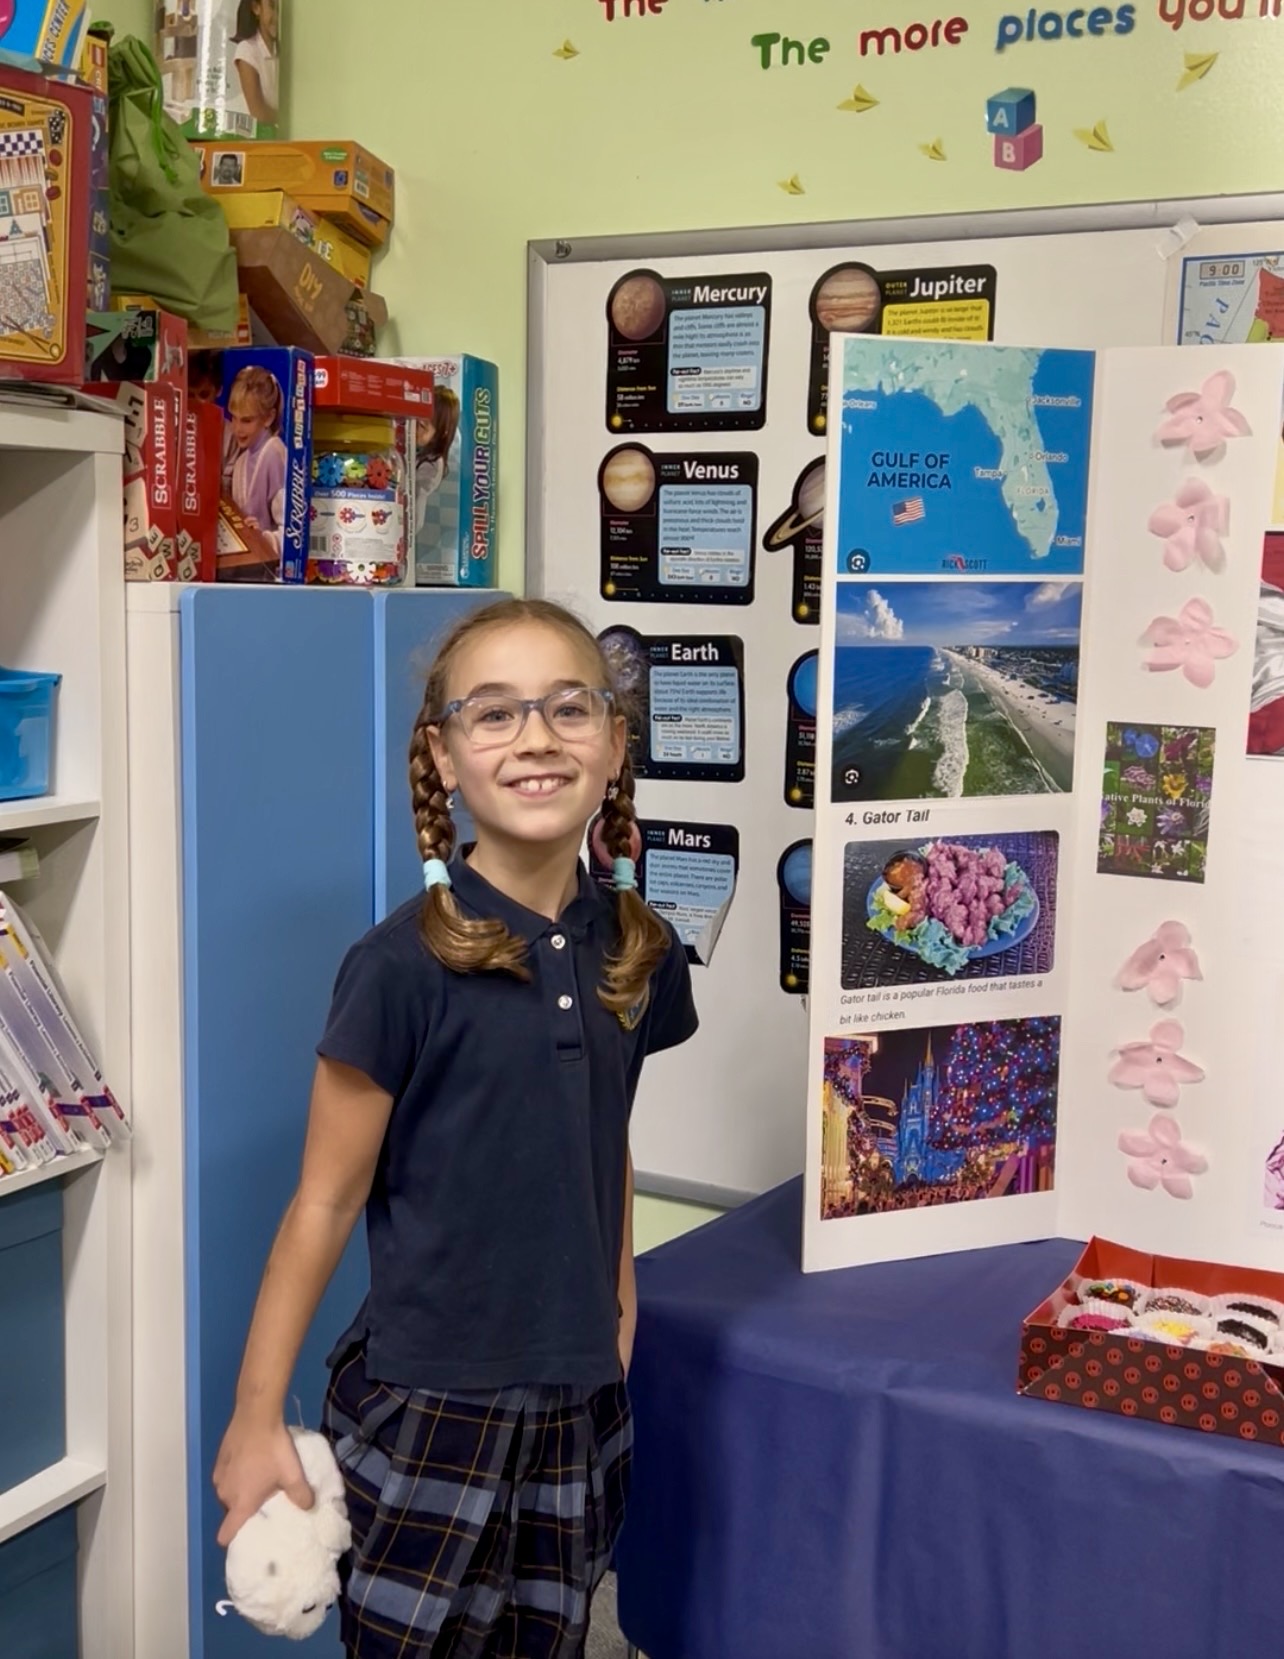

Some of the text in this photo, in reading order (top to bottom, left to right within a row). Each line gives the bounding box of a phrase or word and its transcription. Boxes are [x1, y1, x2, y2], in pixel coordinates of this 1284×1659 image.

[751, 0, 1281, 70] The more places youll
[992, 107, 1009, 128] A
[1002, 141, 1016, 162] B
[693, 285, 767, 304] Mercury
[910, 275, 987, 300] Jupiter
[1032, 396, 1081, 407] Jacksonville
[153, 398, 168, 504] SCRABBLE
[1035, 451, 1068, 462] Orlando
[184, 412, 197, 512] SCRABBLE
[871, 452, 950, 469] GULF OF
[472, 387, 491, 560] SPILL YOUR GUTS
[683, 461, 740, 479] Venus
[974, 468, 1003, 480] Tampa
[867, 473, 951, 489] AMERICA
[331, 489, 347, 497] 500
[1017, 488, 1049, 496] FLORIDA
[285, 457, 306, 549] SCRABBLE
[1056, 536, 1080, 546] Miami
[963, 559, 988, 570] SCOTT
[671, 643, 719, 661] Earth
[1102, 793, 1129, 803] ative
[1132, 794, 1163, 805] Plants
[1166, 797, 1176, 806] of
[845, 809, 930, 826] 4. Gator Tail
[668, 828, 711, 848] Mars
[840, 994, 865, 1005] Gator
[867, 992, 882, 1003] tail
[883, 992, 891, 1001] is
[900, 988, 934, 1001] popular
[936, 985, 966, 997] Florida
[967, 983, 988, 994] food
[989, 981, 1007, 992] that
[1008, 980, 1036, 990] tastes
[839, 1010, 906, 1025] bit like chicken.
